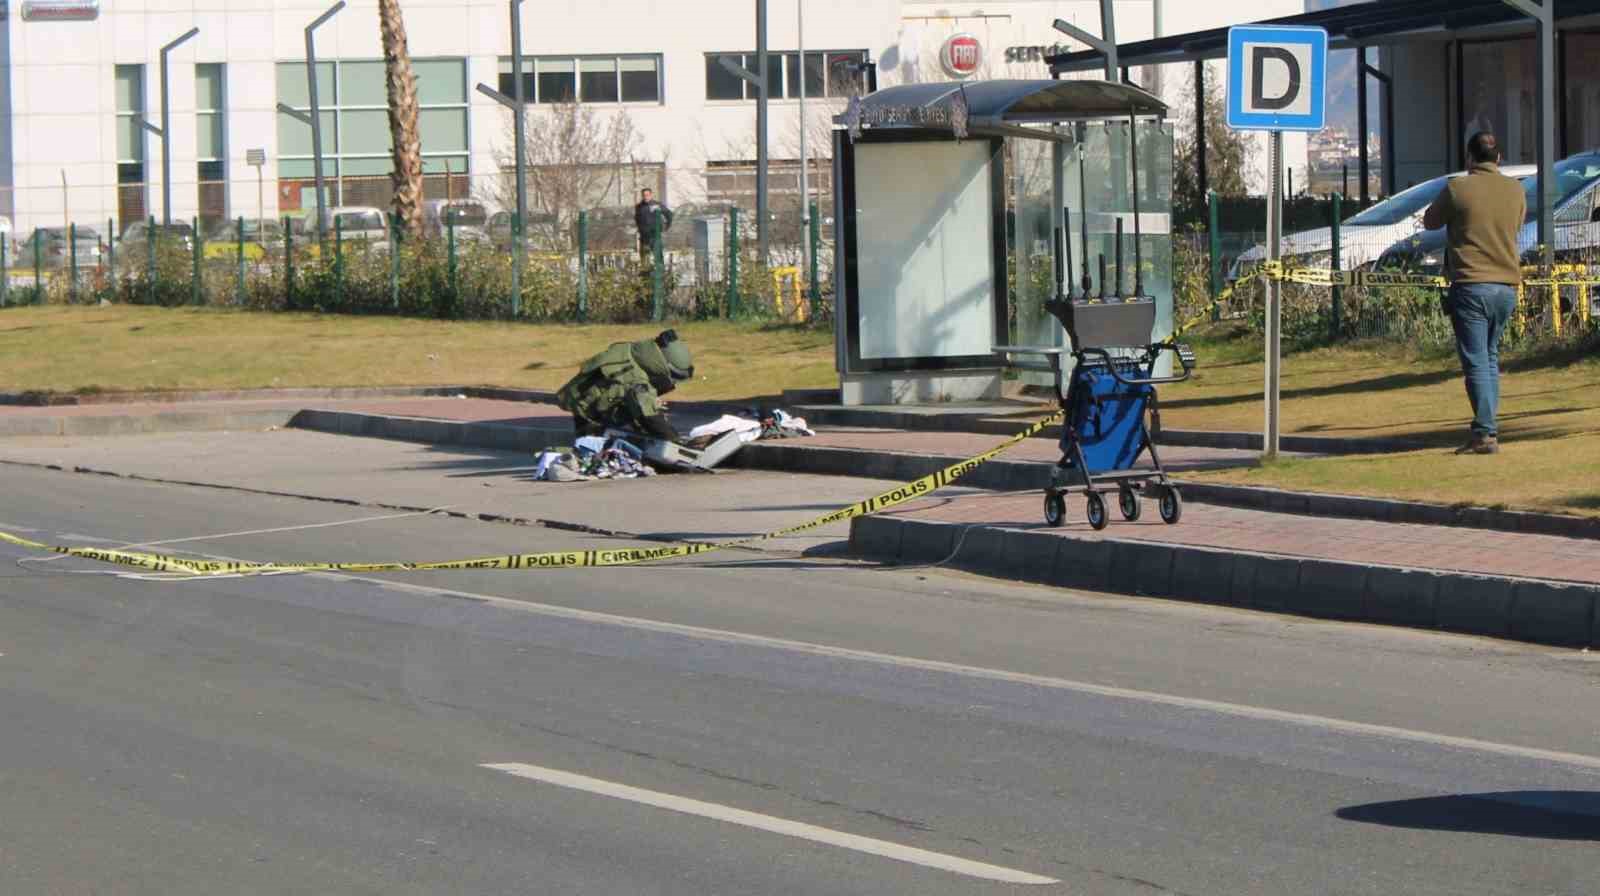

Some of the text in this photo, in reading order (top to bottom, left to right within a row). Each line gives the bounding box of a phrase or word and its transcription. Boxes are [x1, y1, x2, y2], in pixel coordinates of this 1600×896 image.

[953, 44, 976, 65] FIAT
[1251, 46, 1301, 109] D
[527, 553, 576, 567] POLIS
[879, 480, 928, 506] POLIS
